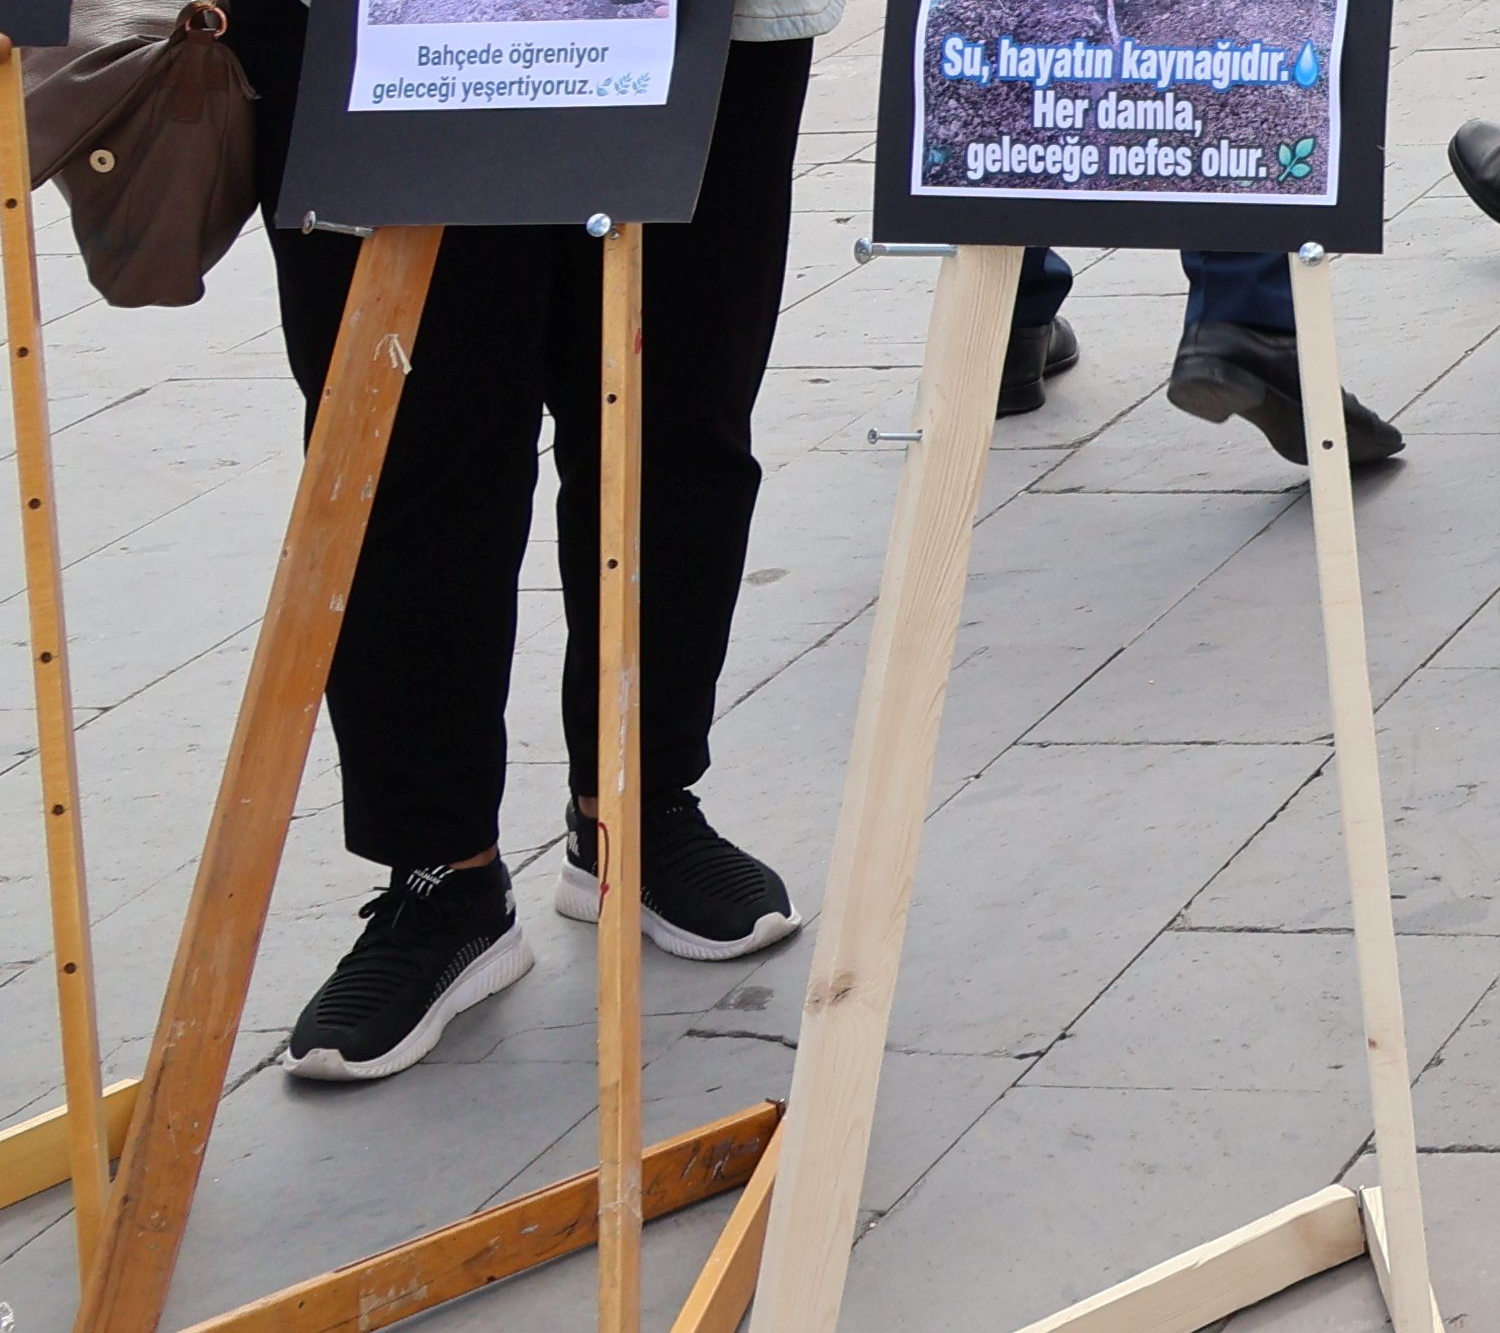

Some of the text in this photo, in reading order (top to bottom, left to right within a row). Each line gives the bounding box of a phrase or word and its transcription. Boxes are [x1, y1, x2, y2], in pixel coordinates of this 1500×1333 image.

[417, 42, 609, 70] Bahçede öğreniyor
[944, 36, 1289, 89] Su, hayatın kaynağıdır.
[372, 74, 593, 104] geleceği yeşertiyoruz.
[1033, 90, 1203, 134] Her damla,
[967, 135, 1266, 183] geleceğe nefes olur.
